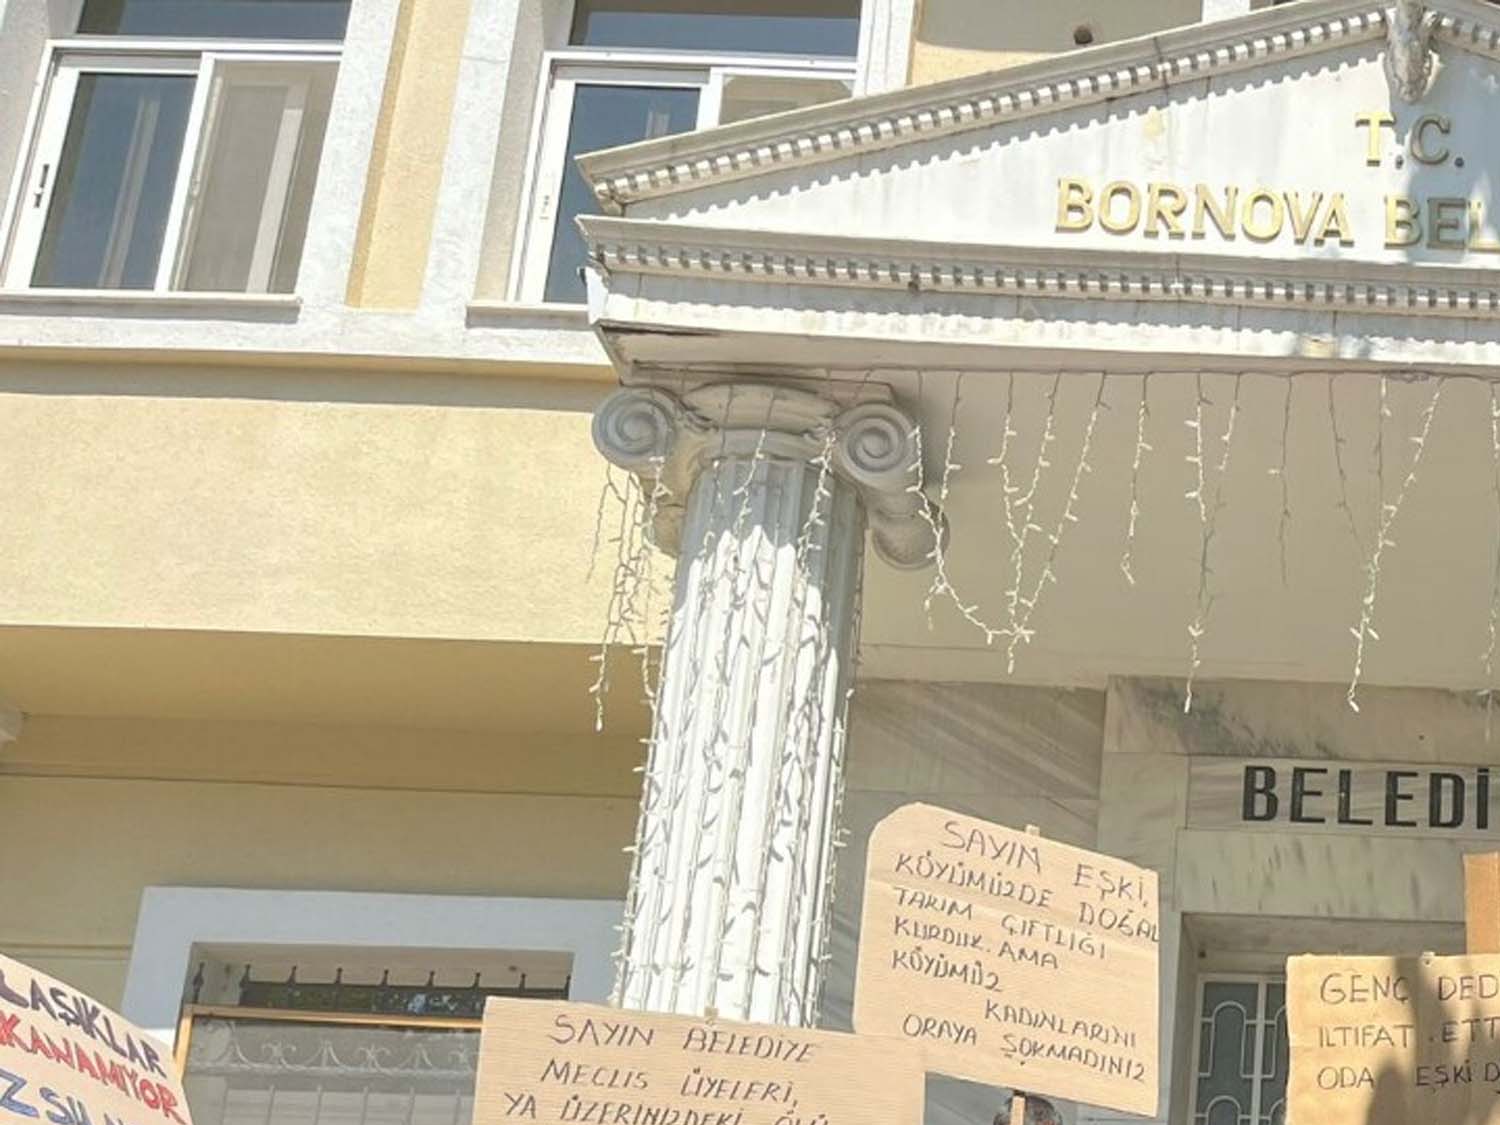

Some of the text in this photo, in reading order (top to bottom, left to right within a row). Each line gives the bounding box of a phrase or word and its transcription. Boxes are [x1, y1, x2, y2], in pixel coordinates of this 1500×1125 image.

[1355, 112, 1464, 169] T.C.
[1056, 177, 1355, 248] BORNOVA
[942, 821, 1041, 873] SAYIN
[895, 850, 1053, 908] KÖYÜMÜZDE
[893, 887, 972, 920] TARIM
[998, 941, 1058, 969] AMA
[1320, 973, 1409, 1006] GENÇ
[548, 1014, 654, 1046] SAYIN
[902, 1013, 977, 1046] ORAYA
[985, 1000, 1136, 1048] KADINLARINI
[1317, 1065, 1375, 1090] ODA
[504, 1093, 537, 1120] YA
